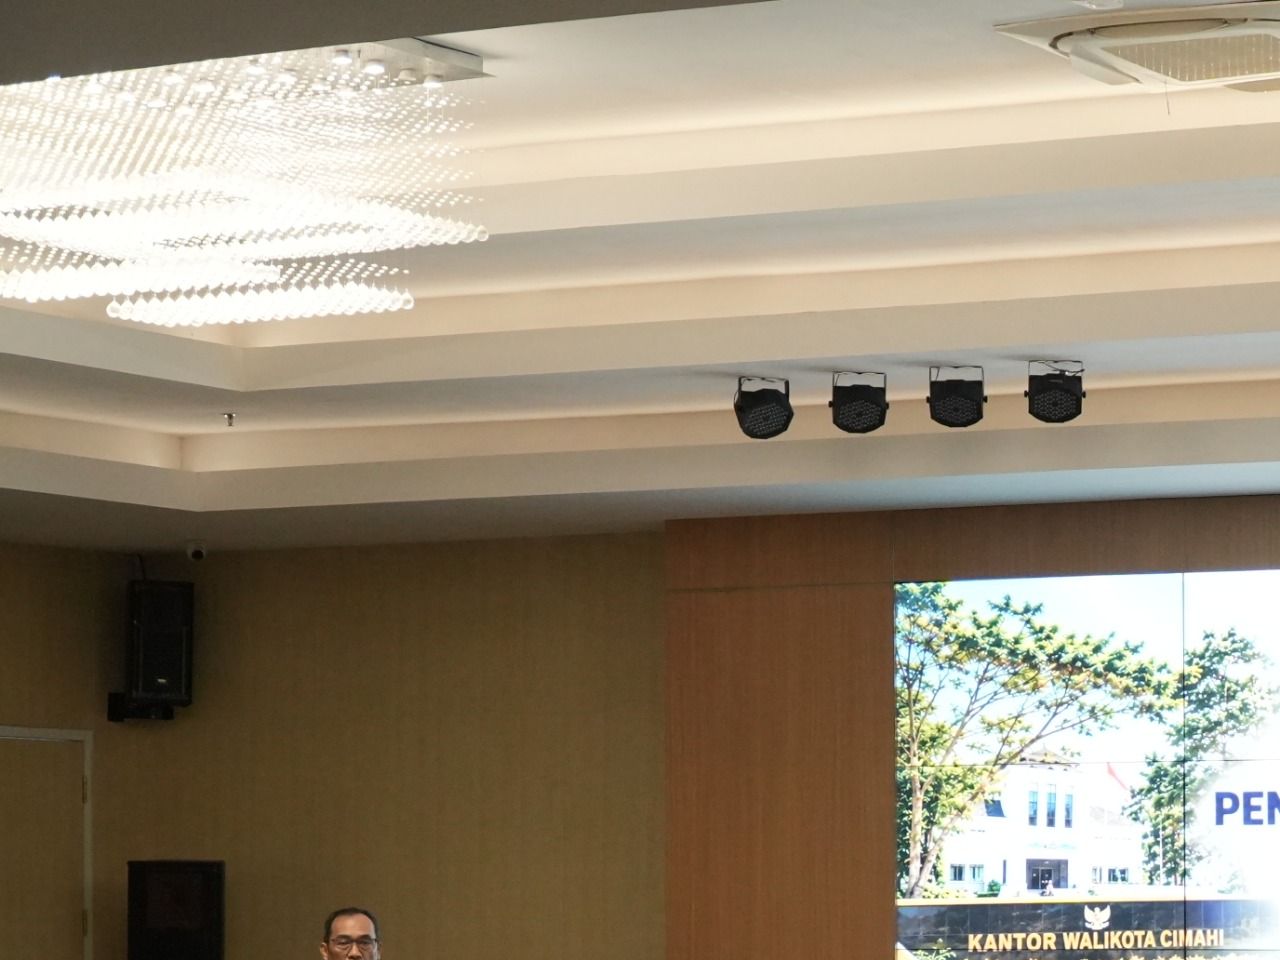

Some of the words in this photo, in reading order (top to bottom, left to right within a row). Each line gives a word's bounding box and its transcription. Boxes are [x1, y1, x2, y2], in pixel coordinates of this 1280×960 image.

[967, 932, 1057, 953] KANTOR
[1062, 930, 1156, 951] WALIKOTA
[1160, 928, 1224, 948] CIMAHI
